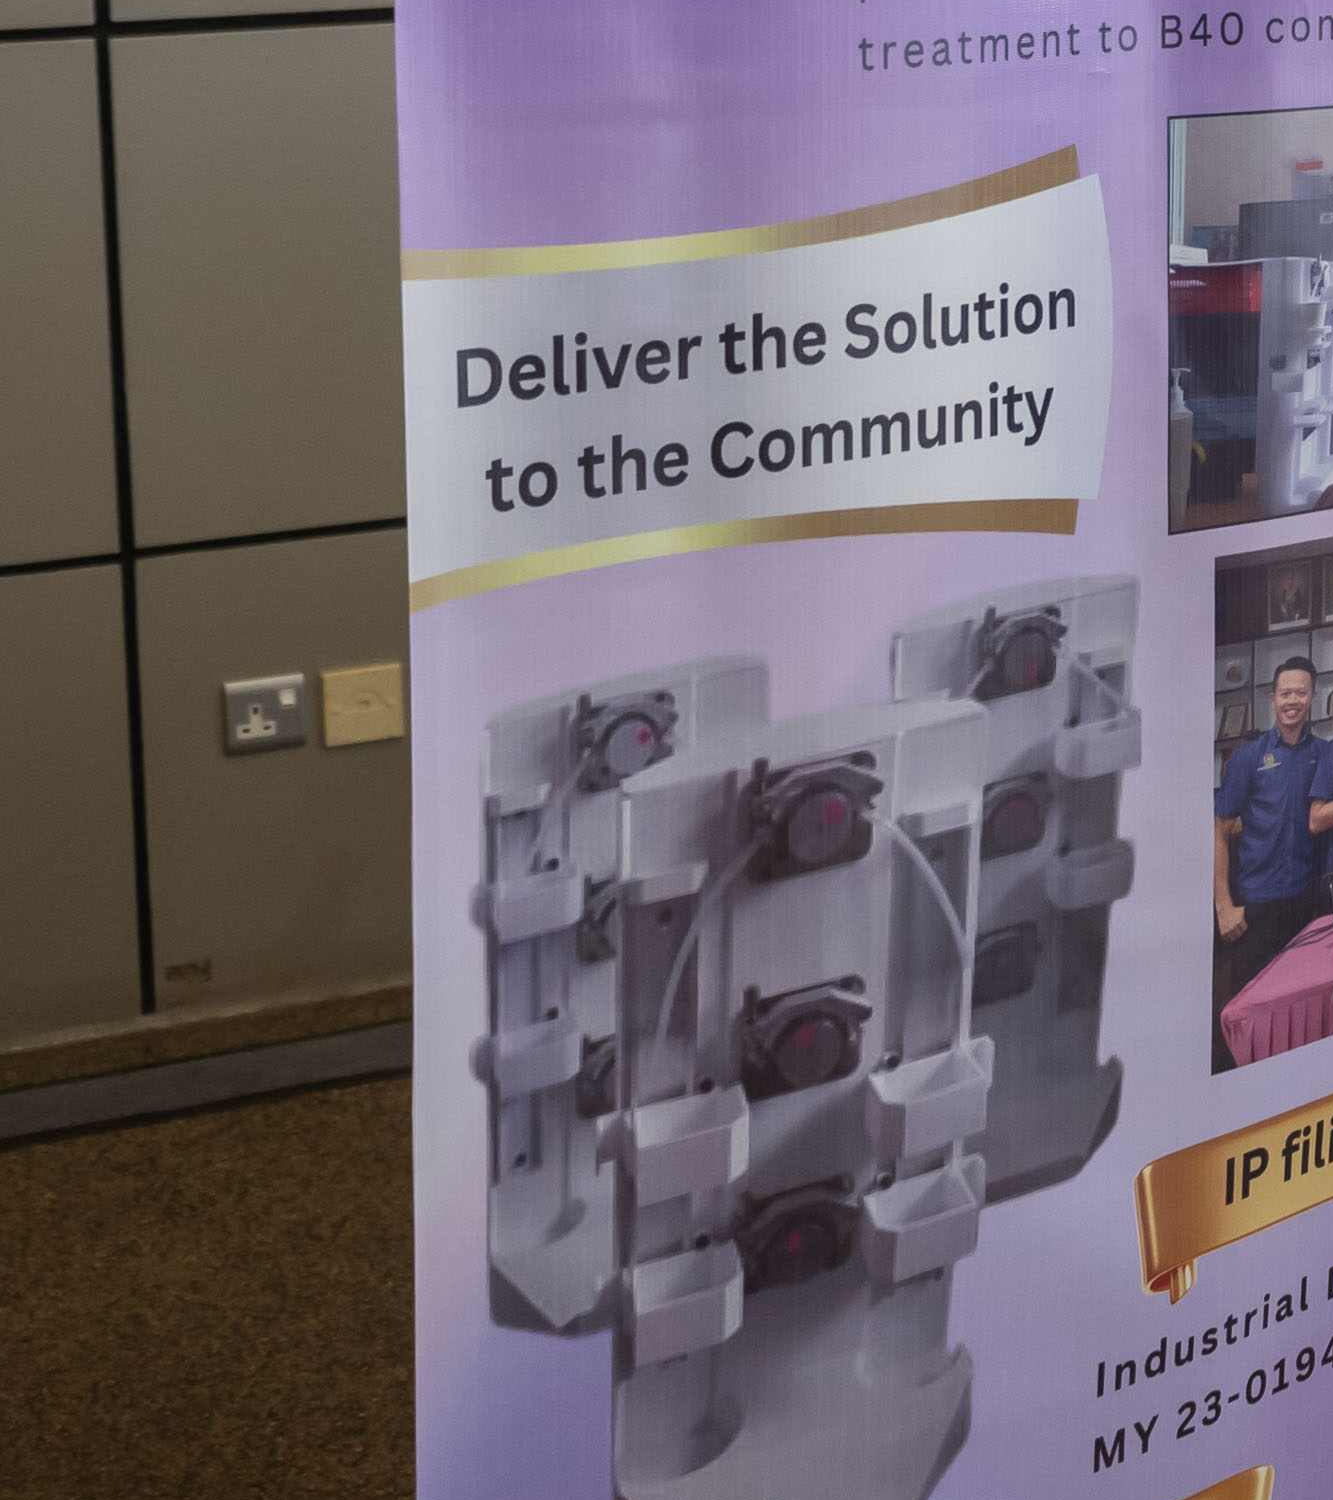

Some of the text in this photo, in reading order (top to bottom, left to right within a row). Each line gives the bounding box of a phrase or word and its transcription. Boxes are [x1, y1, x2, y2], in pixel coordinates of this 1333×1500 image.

[858, 23, 1081, 71] treatment
[1098, 21, 1138, 53] to
[1160, 12, 1244, 49] B40
[455, 281, 1076, 409] Deliver the Solution
[485, 382, 1055, 513] to the Community
[1224, 1152, 1268, 1206] IP
[1098, 1277, 1307, 1397] Industrial
[1094, 1416, 1157, 1472] MY
